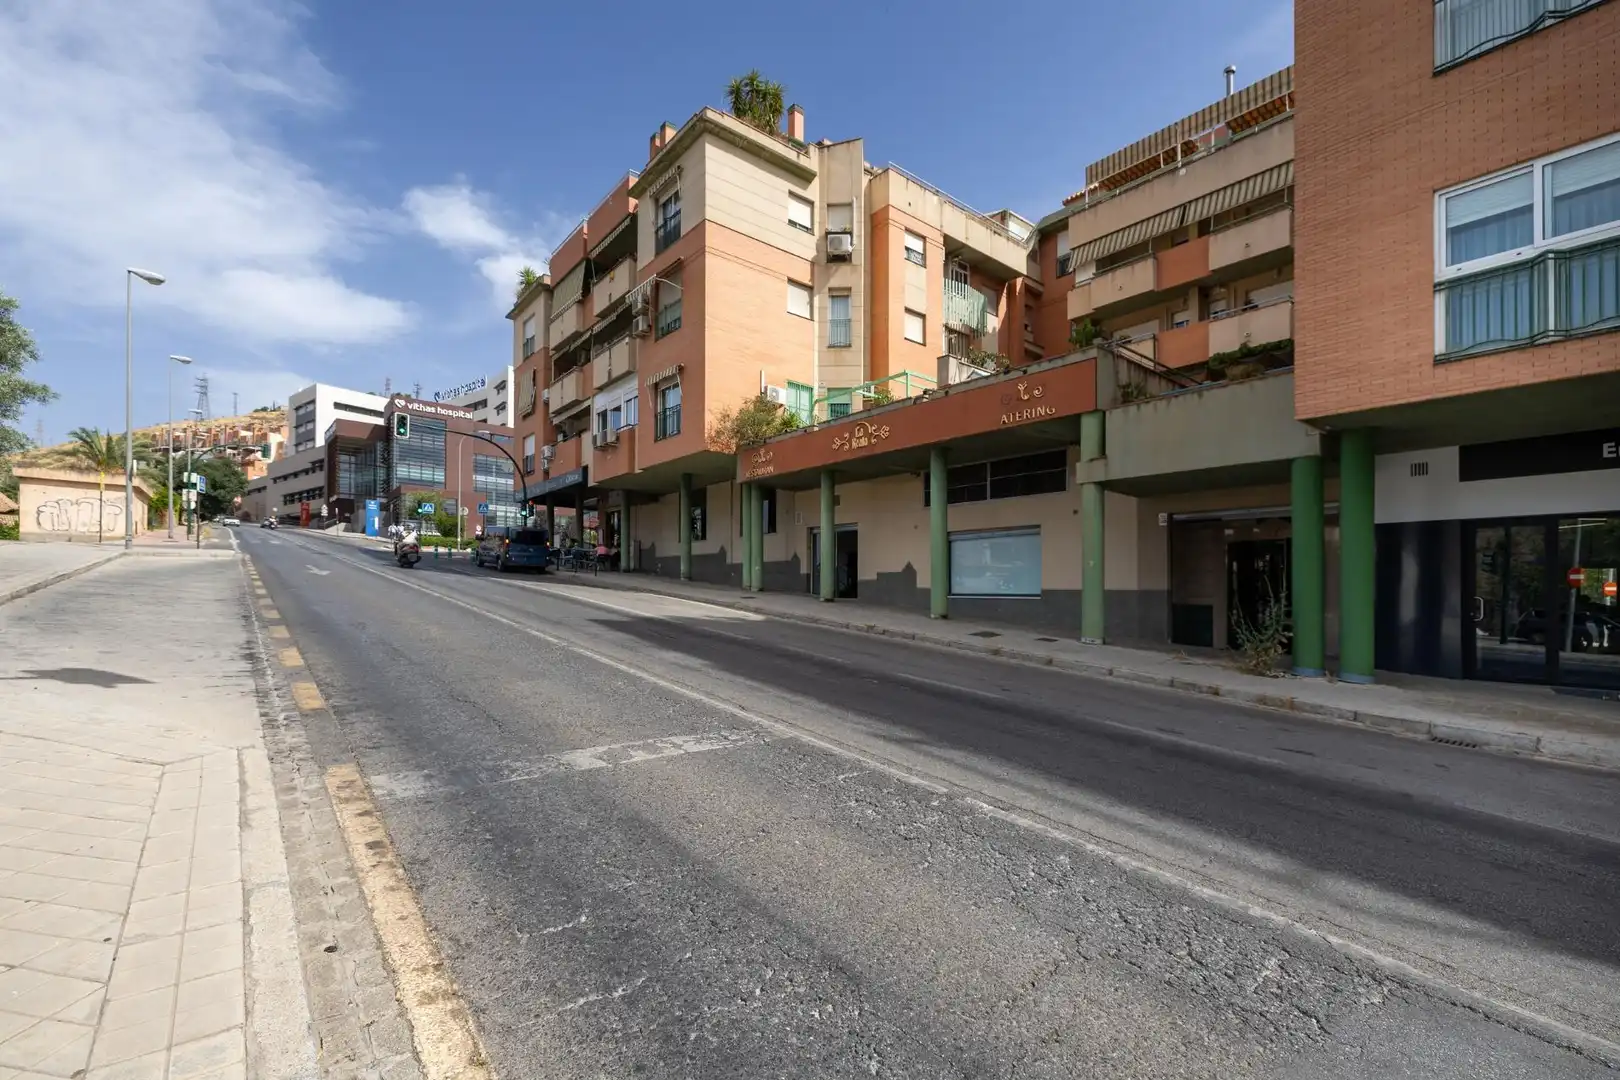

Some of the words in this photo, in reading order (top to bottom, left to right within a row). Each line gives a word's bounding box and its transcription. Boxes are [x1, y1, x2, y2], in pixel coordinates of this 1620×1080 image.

[407, 402, 436, 413] vithas
[437, 406, 473, 420] hospital
[1602, 442, 1620, 458] E
